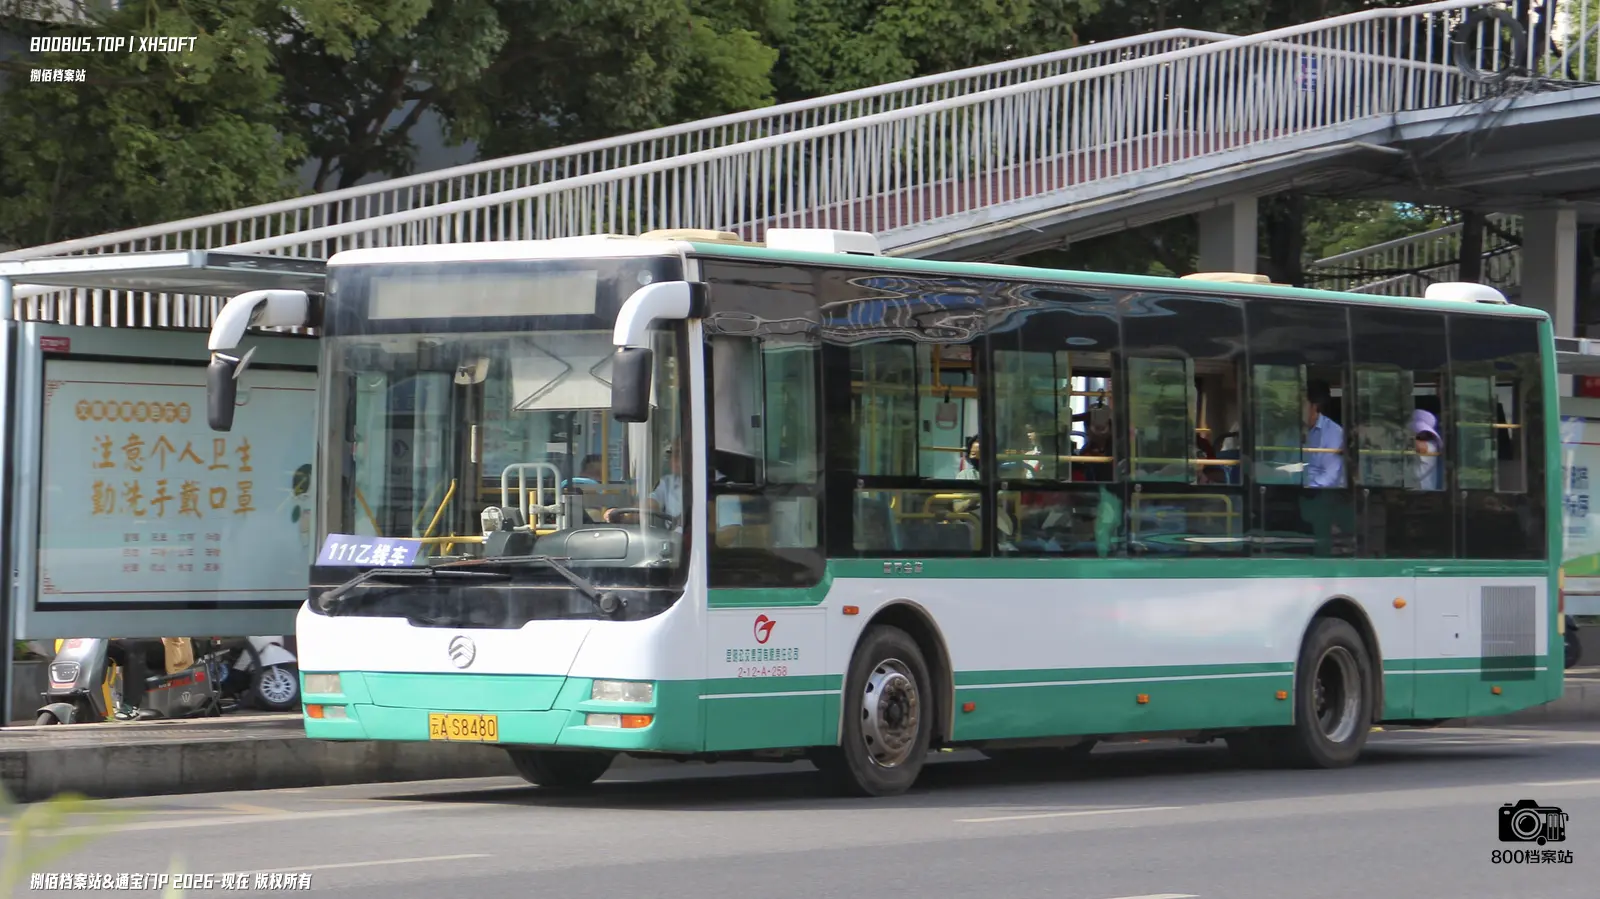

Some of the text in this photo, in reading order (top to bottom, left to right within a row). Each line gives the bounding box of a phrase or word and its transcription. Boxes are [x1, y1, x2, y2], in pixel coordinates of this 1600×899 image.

[91, 432, 256, 473] 注意个人卫生
[90, 477, 257, 518] 勤洗手戴口罩
[328, 542, 409, 566] 111乙线车
